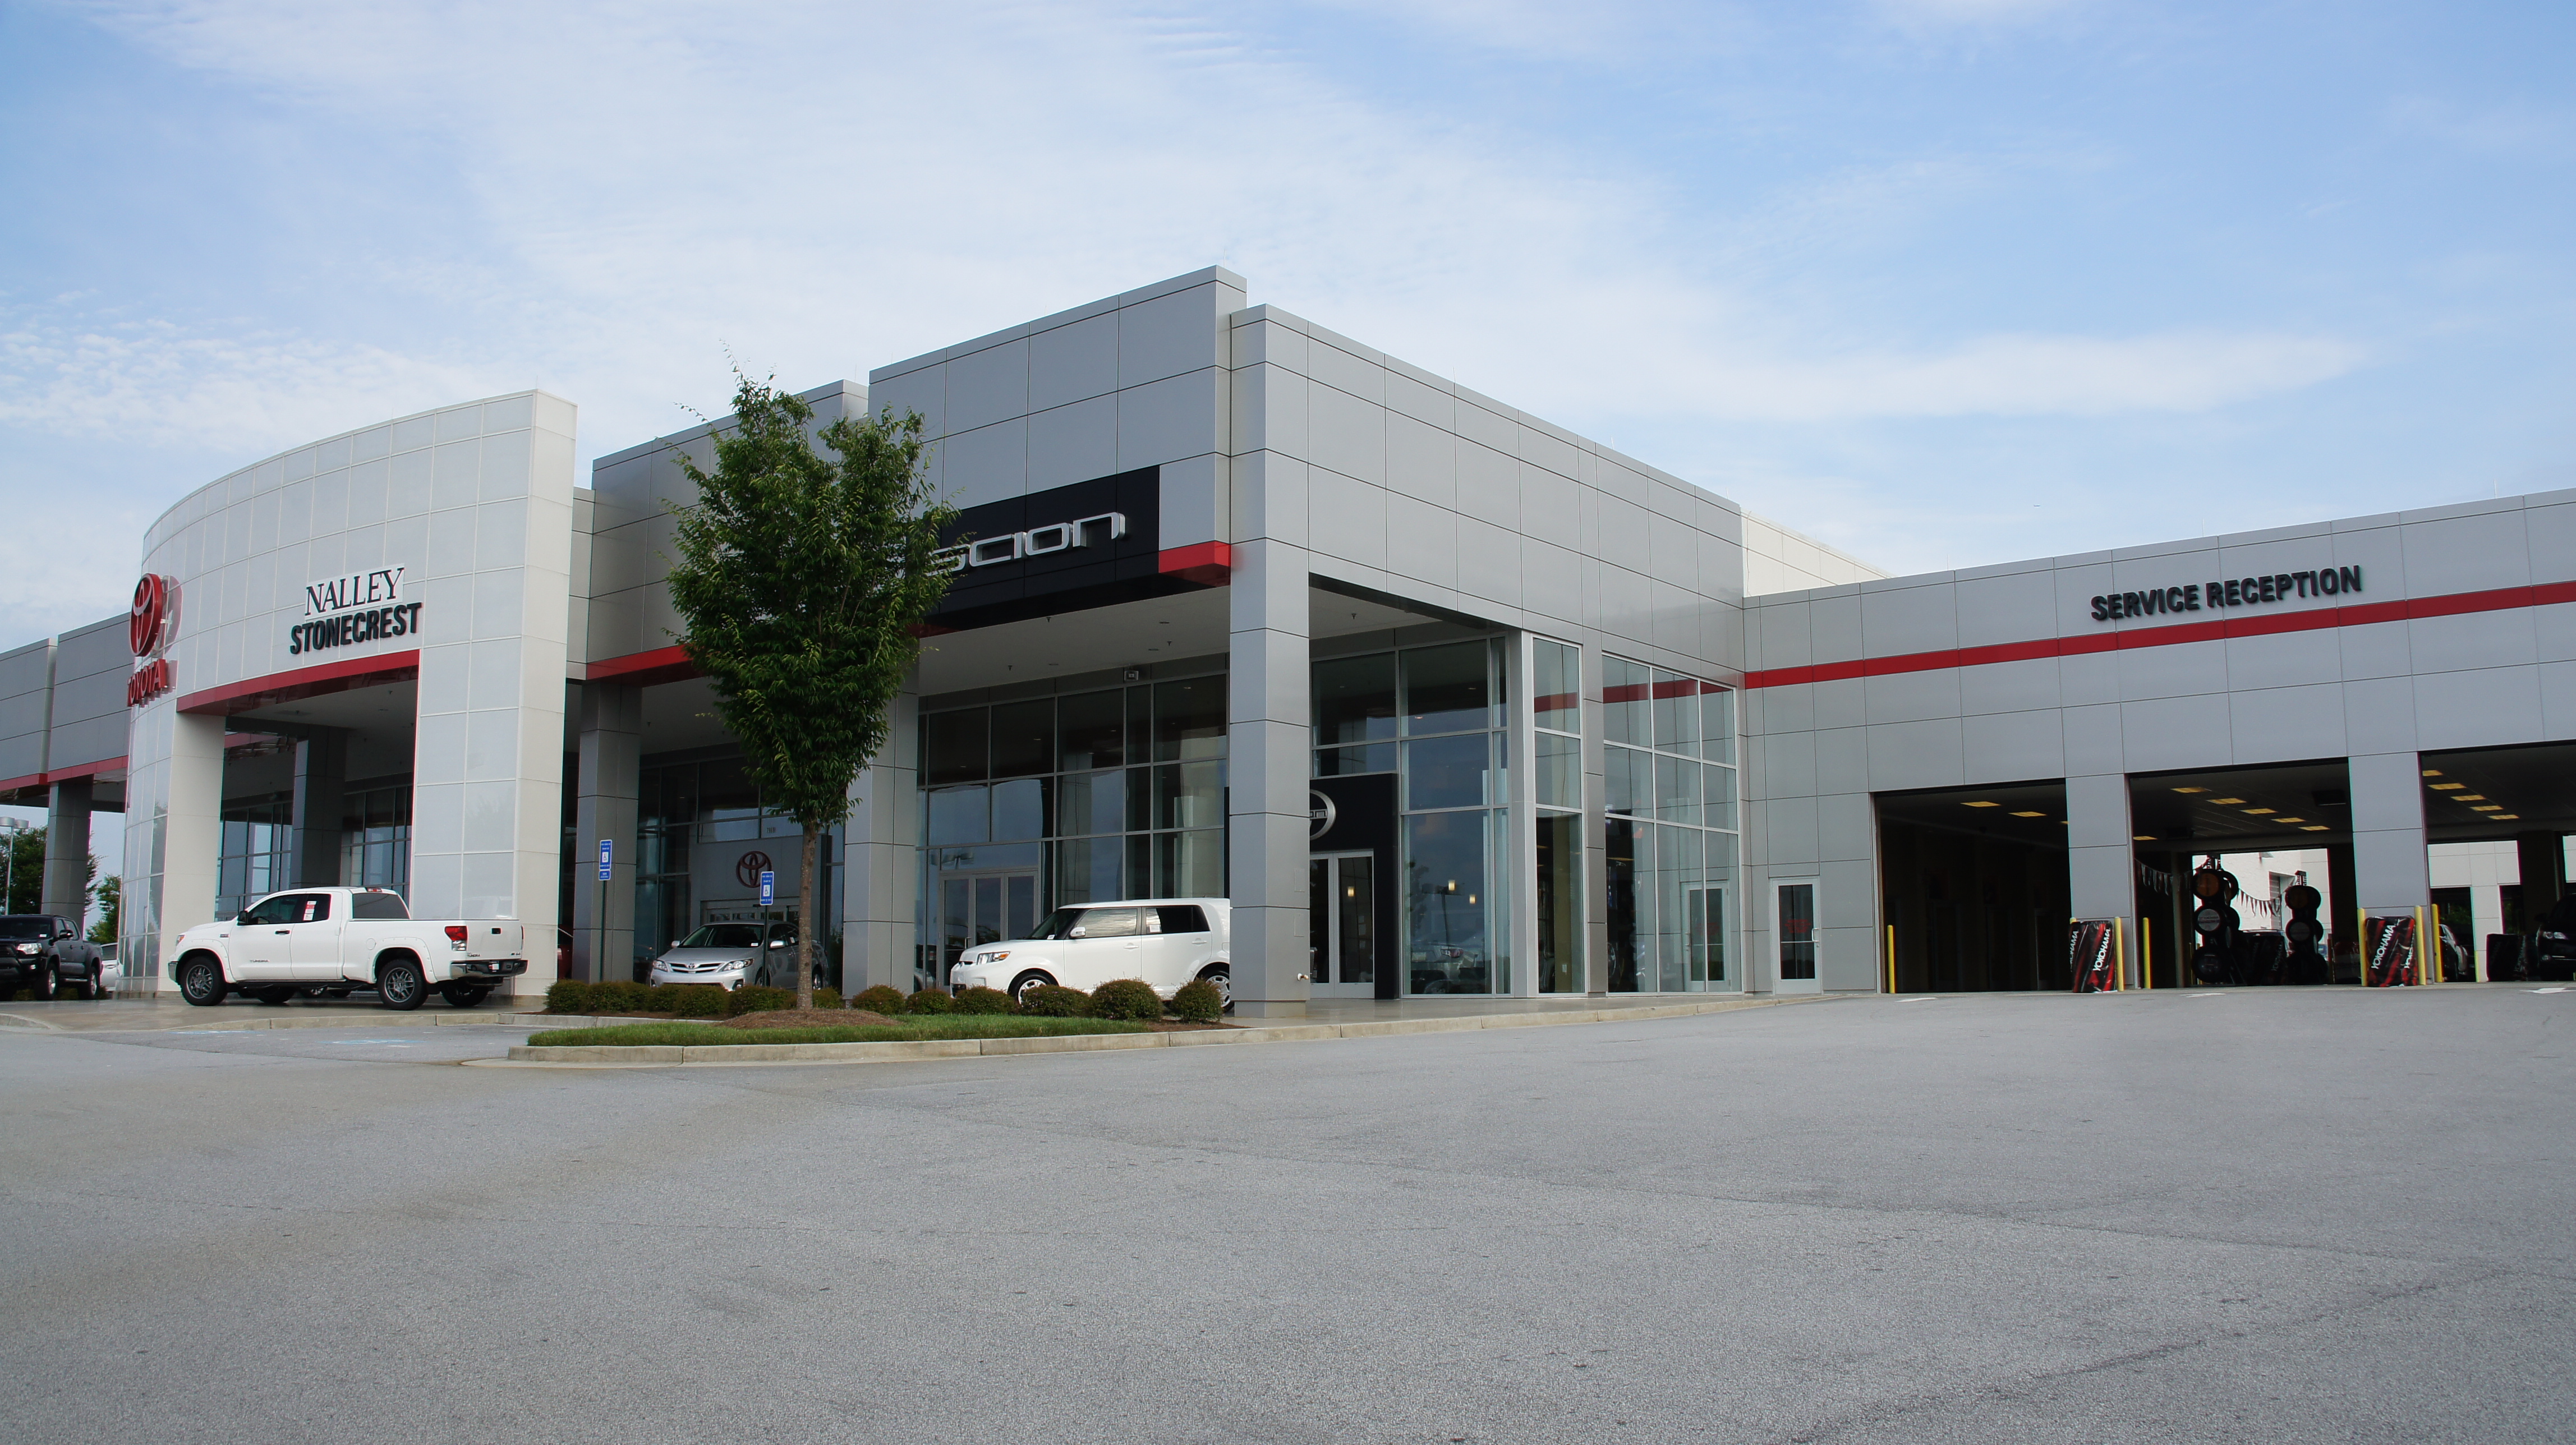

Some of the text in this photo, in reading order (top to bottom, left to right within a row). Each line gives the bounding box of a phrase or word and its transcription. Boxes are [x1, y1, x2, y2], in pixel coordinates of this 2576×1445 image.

[305, 567, 405, 616] NALLEY
[2091, 565, 2362, 620] SERVICE RECEPTION
[289, 602, 424, 655] STONECREST
[127, 658, 167, 707] TOYOTA
[2092, 928, 2111, 971] YOKOHAMA
[2371, 924, 2396, 969] YOKOHAMA
